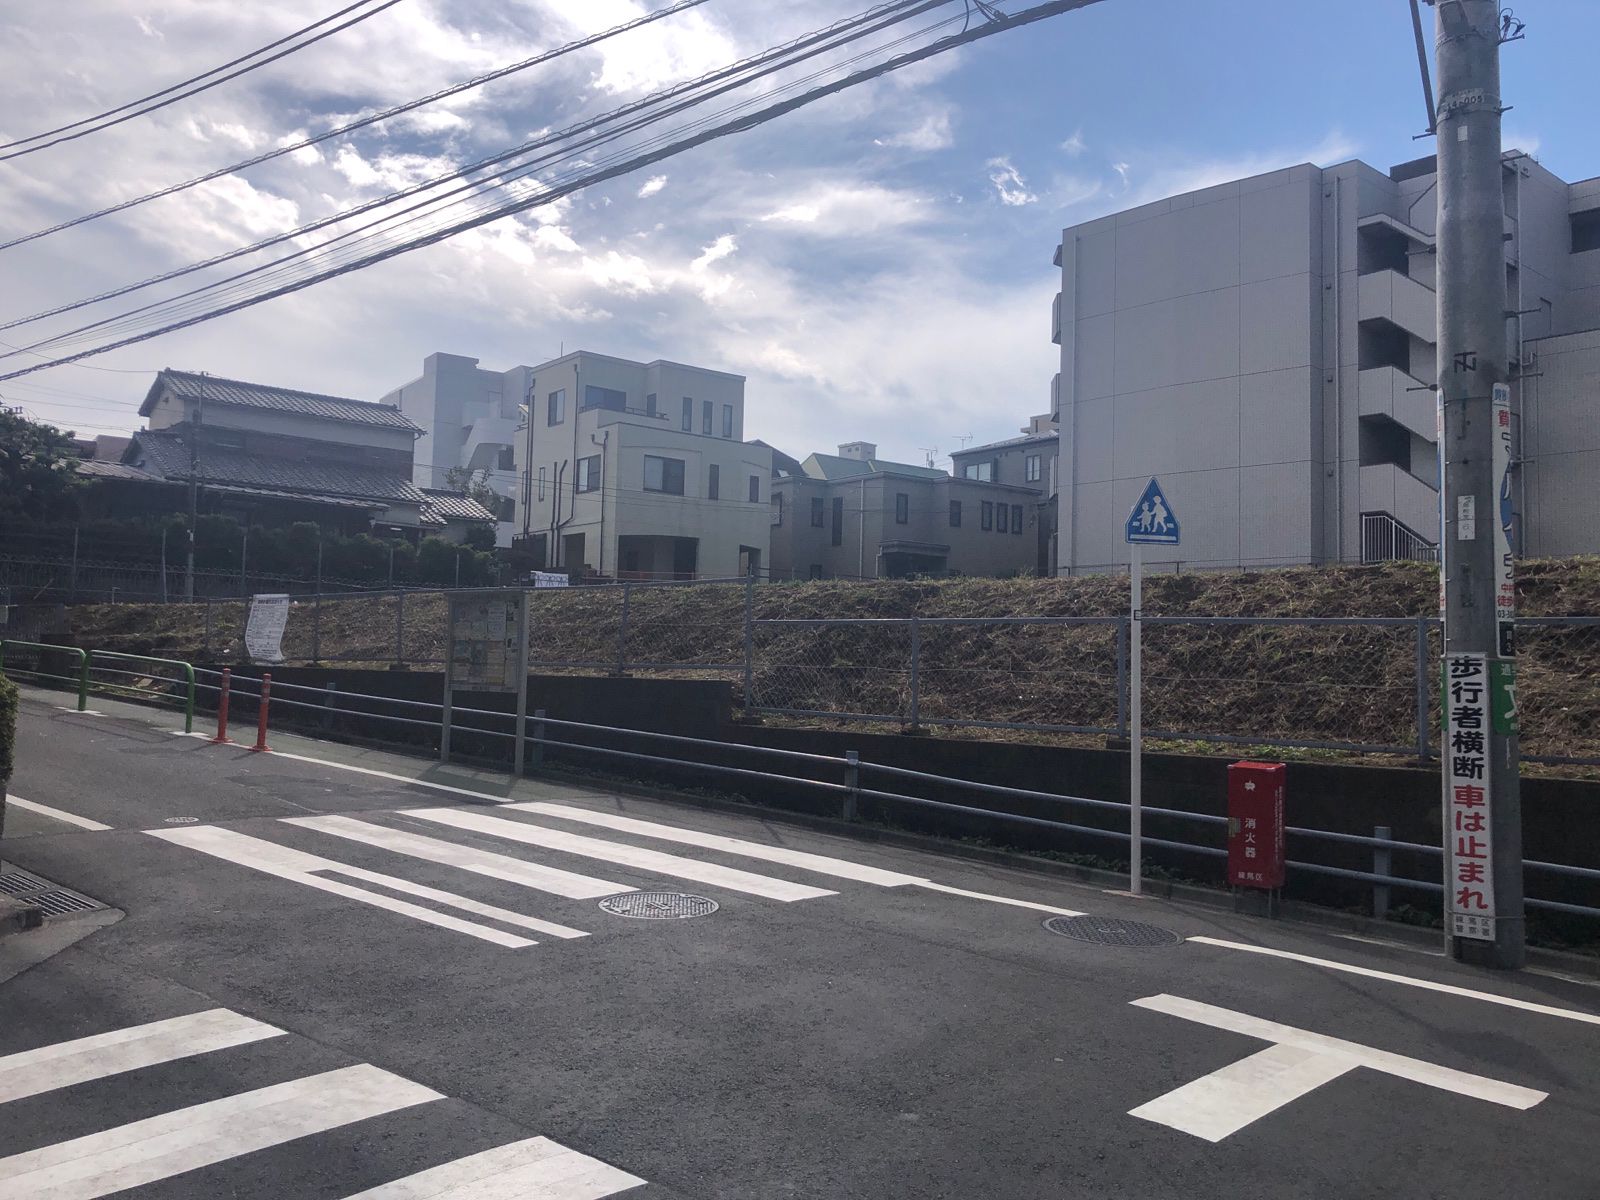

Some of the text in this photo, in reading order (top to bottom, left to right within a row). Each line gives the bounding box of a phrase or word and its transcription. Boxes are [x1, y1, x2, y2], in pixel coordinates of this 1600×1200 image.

[1244, 817, 1256, 858] 消火器
[1450, 655, 1488, 910] 歩行者横断 車は止まれ
